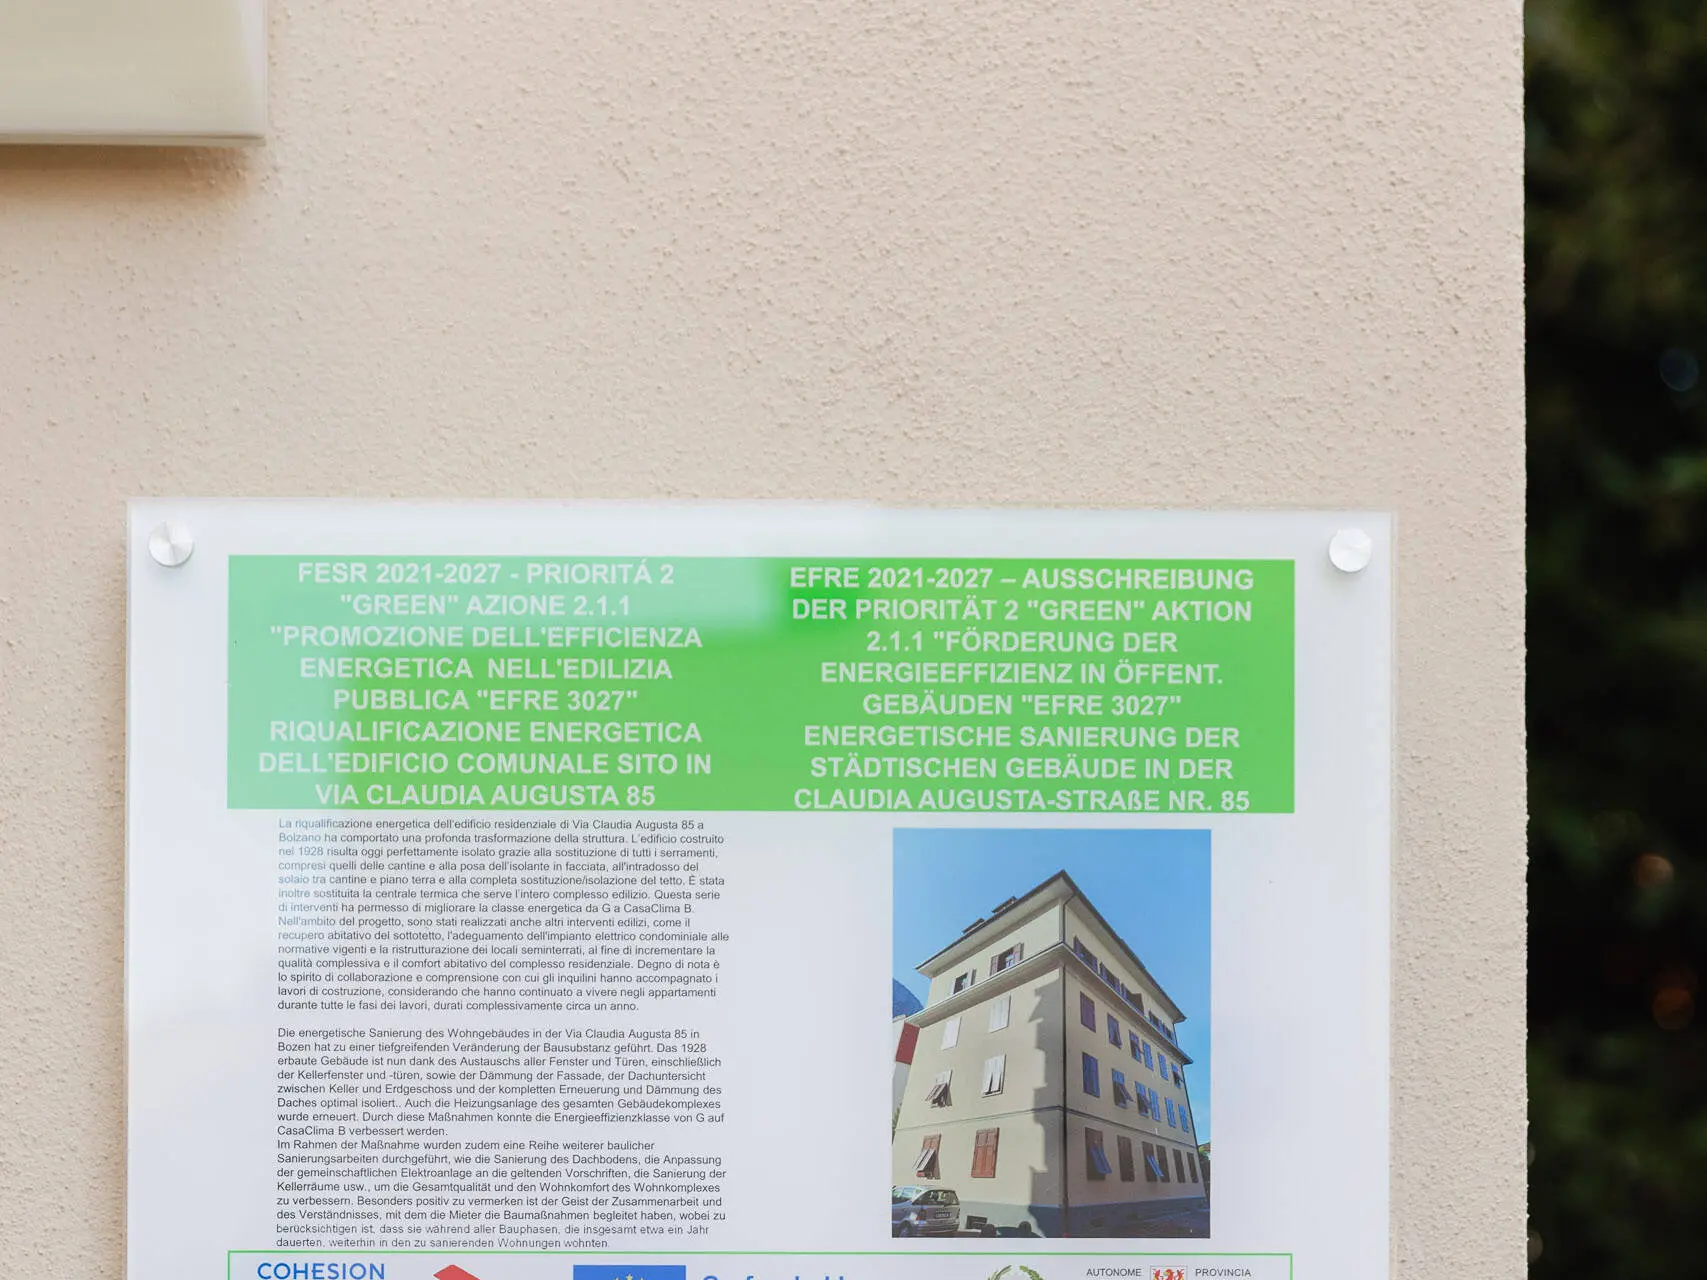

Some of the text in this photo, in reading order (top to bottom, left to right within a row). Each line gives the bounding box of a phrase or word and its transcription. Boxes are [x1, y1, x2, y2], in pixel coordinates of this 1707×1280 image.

[299, 562, 367, 583] FESR
[376, 563, 501, 583] 2021-2027
[660, 564, 674, 584] 2
[791, 566, 859, 588] EFRE
[868, 567, 993, 588] 2021-2027
[1022, 568, 1253, 590] AUSSCHREIBUNG
[466, 595, 565, 615] AZIONE
[574, 595, 629, 616] 2.1.1
[793, 599, 847, 620] DER
[856, 595, 997, 620] PRIORITÄT
[1005, 600, 1018, 620] 2
[1152, 600, 1251, 621] AKTION
[472, 626, 702, 647] DELL'EFFICIENZA
[867, 631, 922, 651] 2.1.1
[1124, 632, 1177, 652] DER
[301, 657, 673, 679] ENERGETICA NELL'EDILIZIA
[822, 659, 1222, 684] ENERGIEEFFIZIENZ IN ÖFFENT.
[333, 689, 470, 710] PUBBLICA
[863, 690, 1012, 715] GEBÄUDEN
[270, 720, 702, 743] RIQUALIFICAZIONE ENERGETICA
[805, 725, 1239, 747] ENERGETISCHE SANIERUNG DER
[259, 752, 711, 774] DELL'EDIFICIO COMUNALE SITO IN
[811, 753, 1233, 779] STÄDTISCHEN GEBÄUDE IN DER
[315, 783, 655, 806] VIA CLAUDIA AUGUSTA 85
[794, 788, 912, 809] CLAUDIA
[1169, 790, 1212, 811] NR.
[1221, 790, 1250, 811] 85
[324, 833, 337, 843] ha
[340, 833, 399, 845] comportato
[402, 834, 422, 843] una
[425, 833, 471, 845] profonda
[474, 833, 551, 843] trasformazione
[554, 833, 579, 843] della
[631, 833, 677, 844] L'edificio
[680, 834, 724, 844] costruito
[277, 1000, 639, 1012] durante tutte le fasi dei lavori, durati complessivamente circa un anno.
[277, 1070, 706, 1083] der Kellerfenster und -türen, sowie der Dämmung der Fassade, der Dachuntersicht
[277, 1125, 448, 1136] CasaClima B verbessert werden.
[277, 1153, 722, 1167] Sanierungsarbeiten durchgeführt, wie die Sanierung des Dachbodens, die Anpassung
[257, 1262, 385, 1280] COHESION
[1086, 1267, 1142, 1277] AUTONOME
[1195, 1268, 1252, 1277] PROVINCIA
